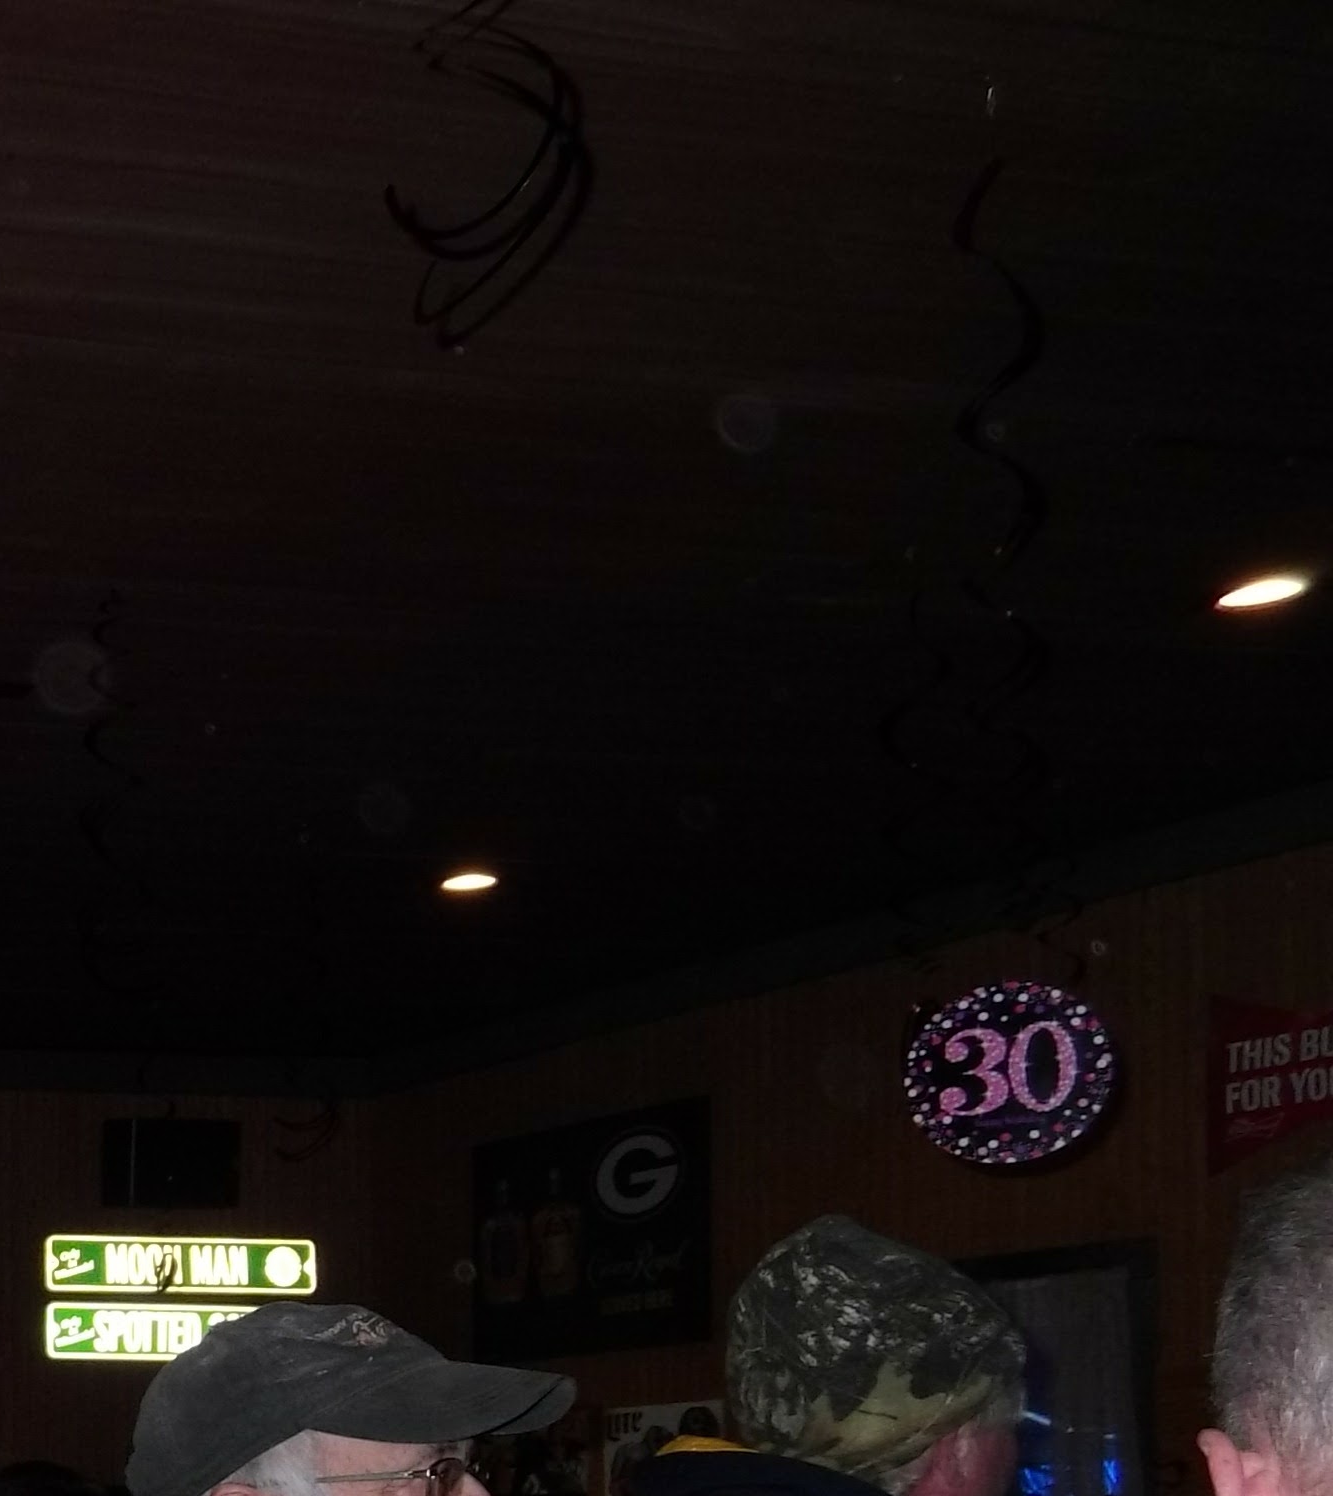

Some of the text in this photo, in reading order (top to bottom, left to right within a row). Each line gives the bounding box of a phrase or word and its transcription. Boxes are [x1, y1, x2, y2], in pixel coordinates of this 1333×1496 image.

[939, 1020, 1078, 1116] 30
[1227, 1032, 1292, 1073] THIS
[1226, 1065, 1333, 1114] FOR YO
[597, 1135, 679, 1215] G
[189, 1245, 249, 1286] MAN
[93, 1311, 202, 1353] SPOTTED
